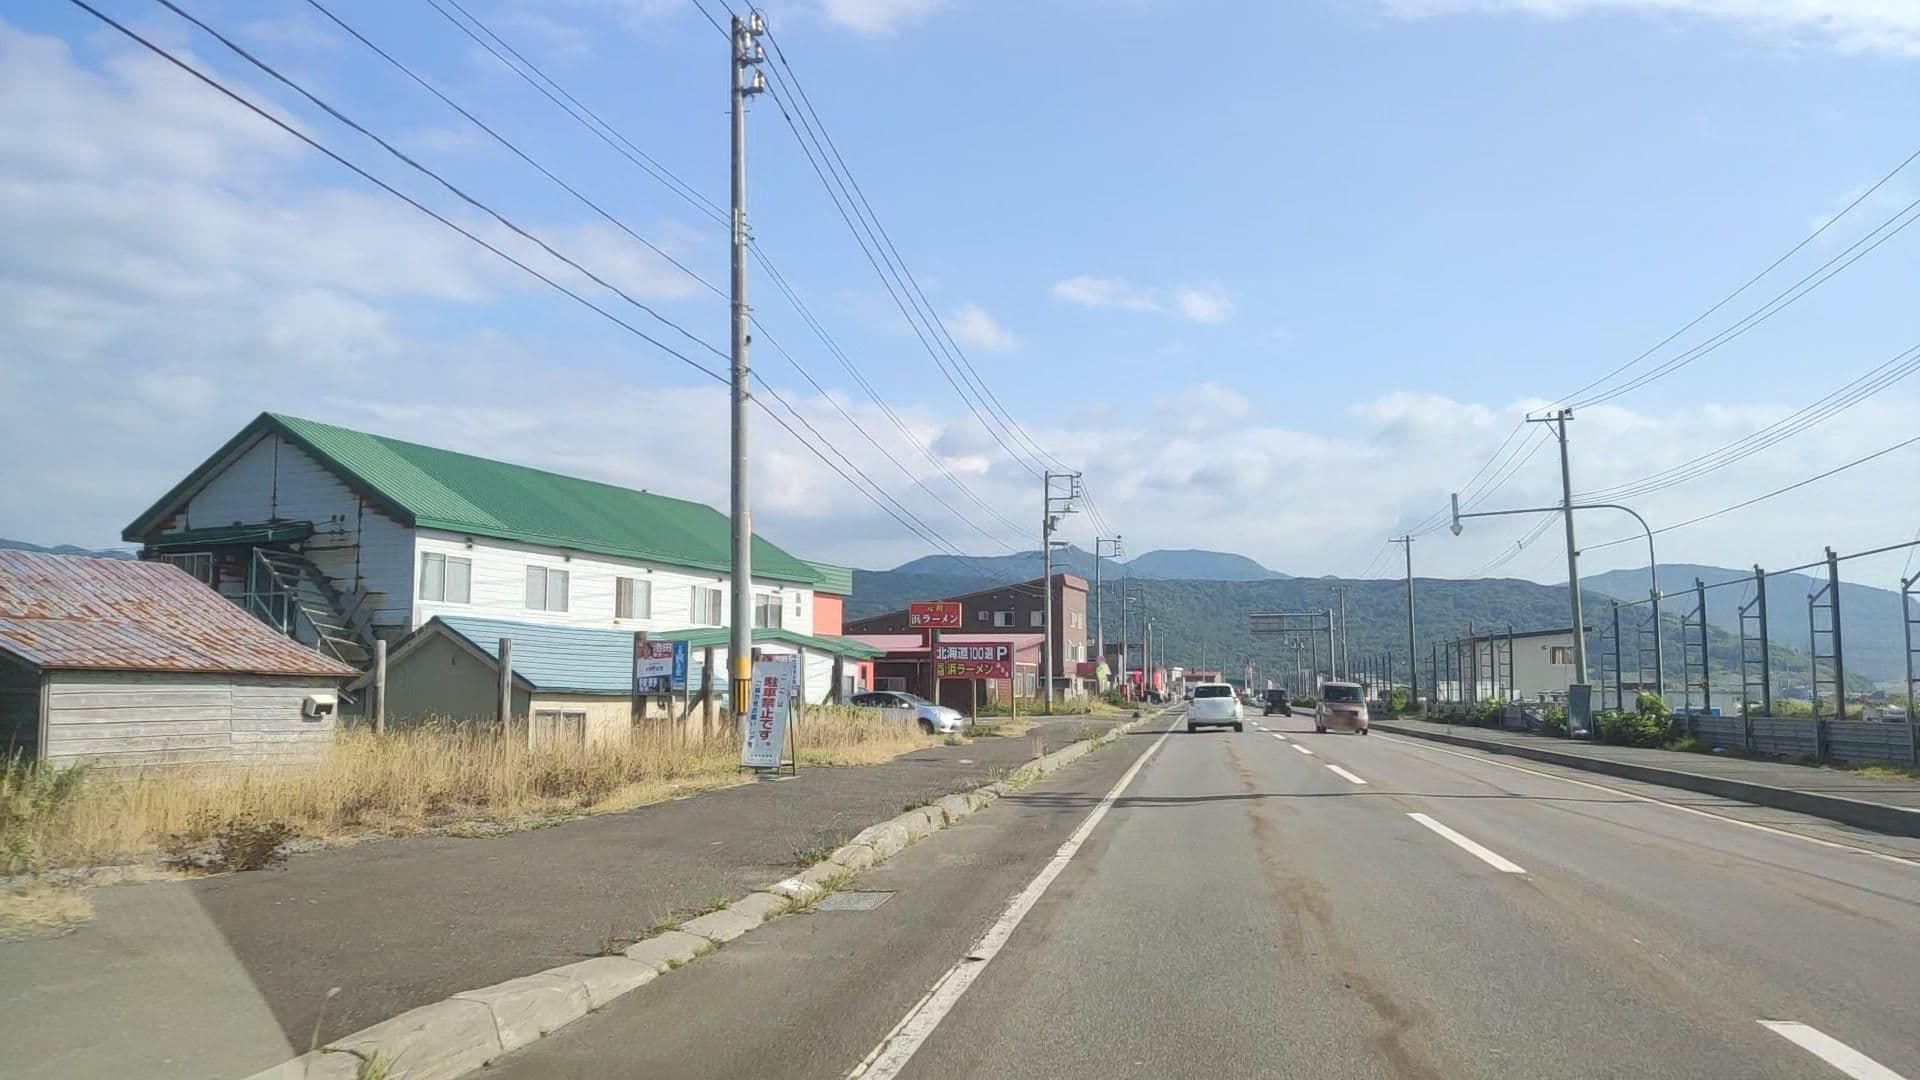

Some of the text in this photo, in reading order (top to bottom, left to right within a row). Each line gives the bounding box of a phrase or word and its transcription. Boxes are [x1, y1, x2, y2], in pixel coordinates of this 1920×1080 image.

[936, 646, 1008, 661] 北海道100選 P
[947, 663, 993, 675] 浜ラーメン
